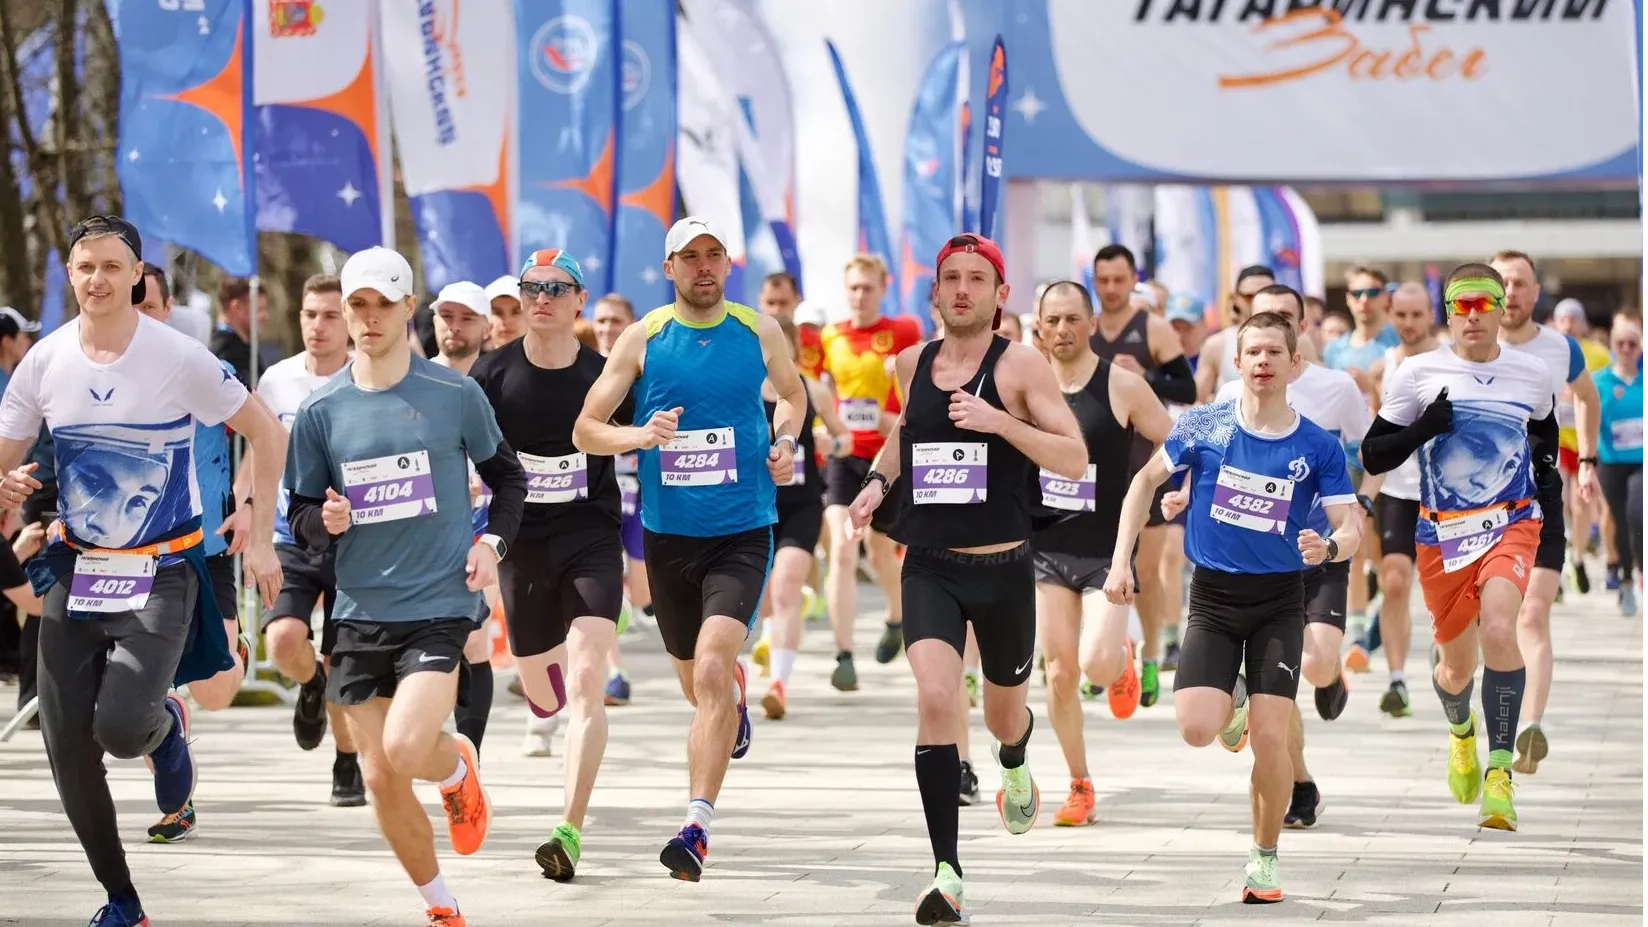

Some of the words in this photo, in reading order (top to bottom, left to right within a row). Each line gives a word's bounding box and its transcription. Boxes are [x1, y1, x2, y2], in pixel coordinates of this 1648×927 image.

[707, 434, 716, 443] A
[399, 458, 409, 468] A
[673, 452, 720, 468] 4284
[560, 461, 568, 469] A
[666, 473, 675, 481] 10
[923, 468, 969, 484] 4286
[528, 475, 573, 488] 4426
[363, 481, 413, 502] 4104
[1266, 483, 1274, 492] A
[1228, 494, 1274, 514] 4382
[356, 511, 366, 519] 10
[1214, 507, 1224, 515] 10
[1484, 520, 1493, 529] A
[1457, 531, 1495, 552] 4261
[1448, 559, 1457, 568] 10
[89, 579, 137, 595] 4012
[74, 598, 85, 606] 10
